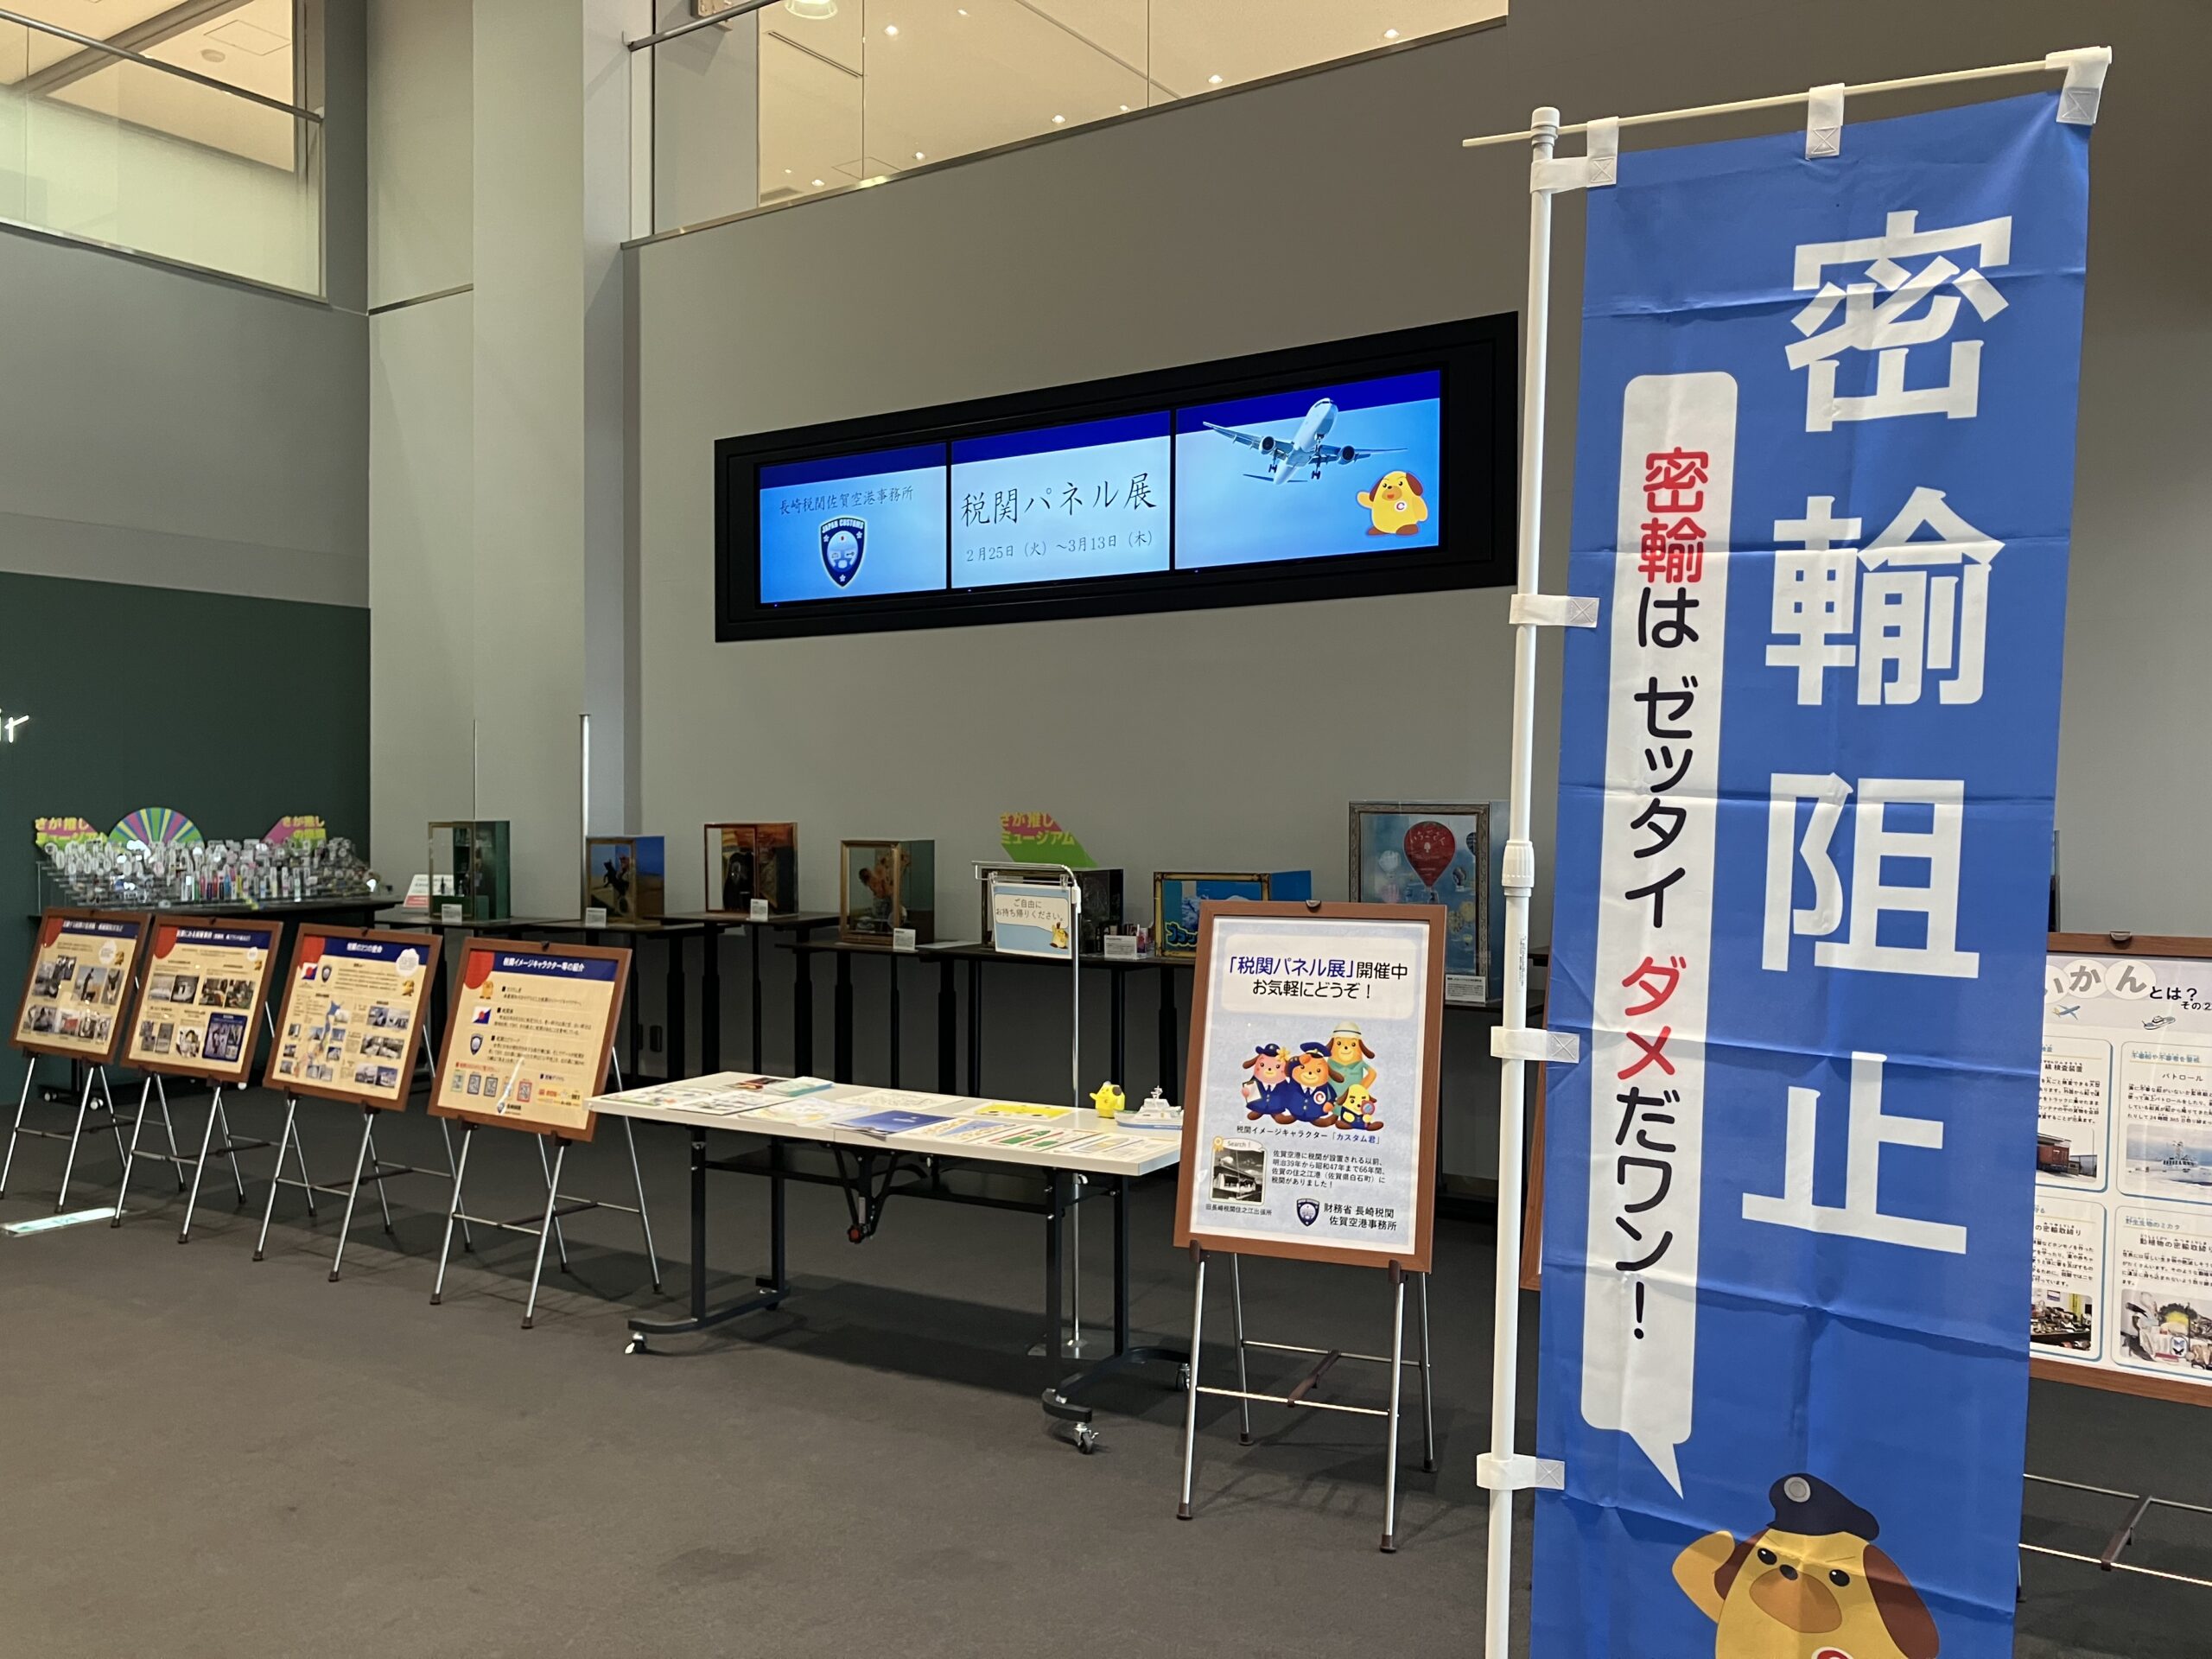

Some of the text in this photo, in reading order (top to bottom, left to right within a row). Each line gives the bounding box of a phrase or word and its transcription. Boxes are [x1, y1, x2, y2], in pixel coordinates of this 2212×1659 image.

[779, 486, 913, 516] 長崎税関佐賀空港事務所
[961, 472, 1157, 528] 税関パネル展
[1636, 445, 1710, 649] 密輸は
[0, 707, 29, 743] r
[1742, 209, 2013, 1256] 密輸阻止
[1623, 672, 1697, 929] ゼッタイ
[1000, 812, 1054, 828] さが推し
[1001, 830, 1075, 846] ミュージアム
[1014, 899, 1042, 908] ご自由に
[995, 908, 1064, 922] お持ち帰りください。
[1230, 957, 1408, 980] 「税関パネル展」開催中
[1253, 979, 1370, 1000] お気軽にどうぞ！
[1236, 1125, 1381, 1145] 税関イメージキャラクター「カスタム君」
[1273, 1150, 1382, 1166] 佐賀空港に税関が設置される以前、
[1273, 1159, 1385, 1175] 明治39年から昭和47年まで66年間、
[1272, 1177, 1332, 1188] 税関がありました！
[1324, 1203, 1395, 1218] 財務省 長崎税関
[1329, 1215, 1397, 1230] 佐賀空港事務所
